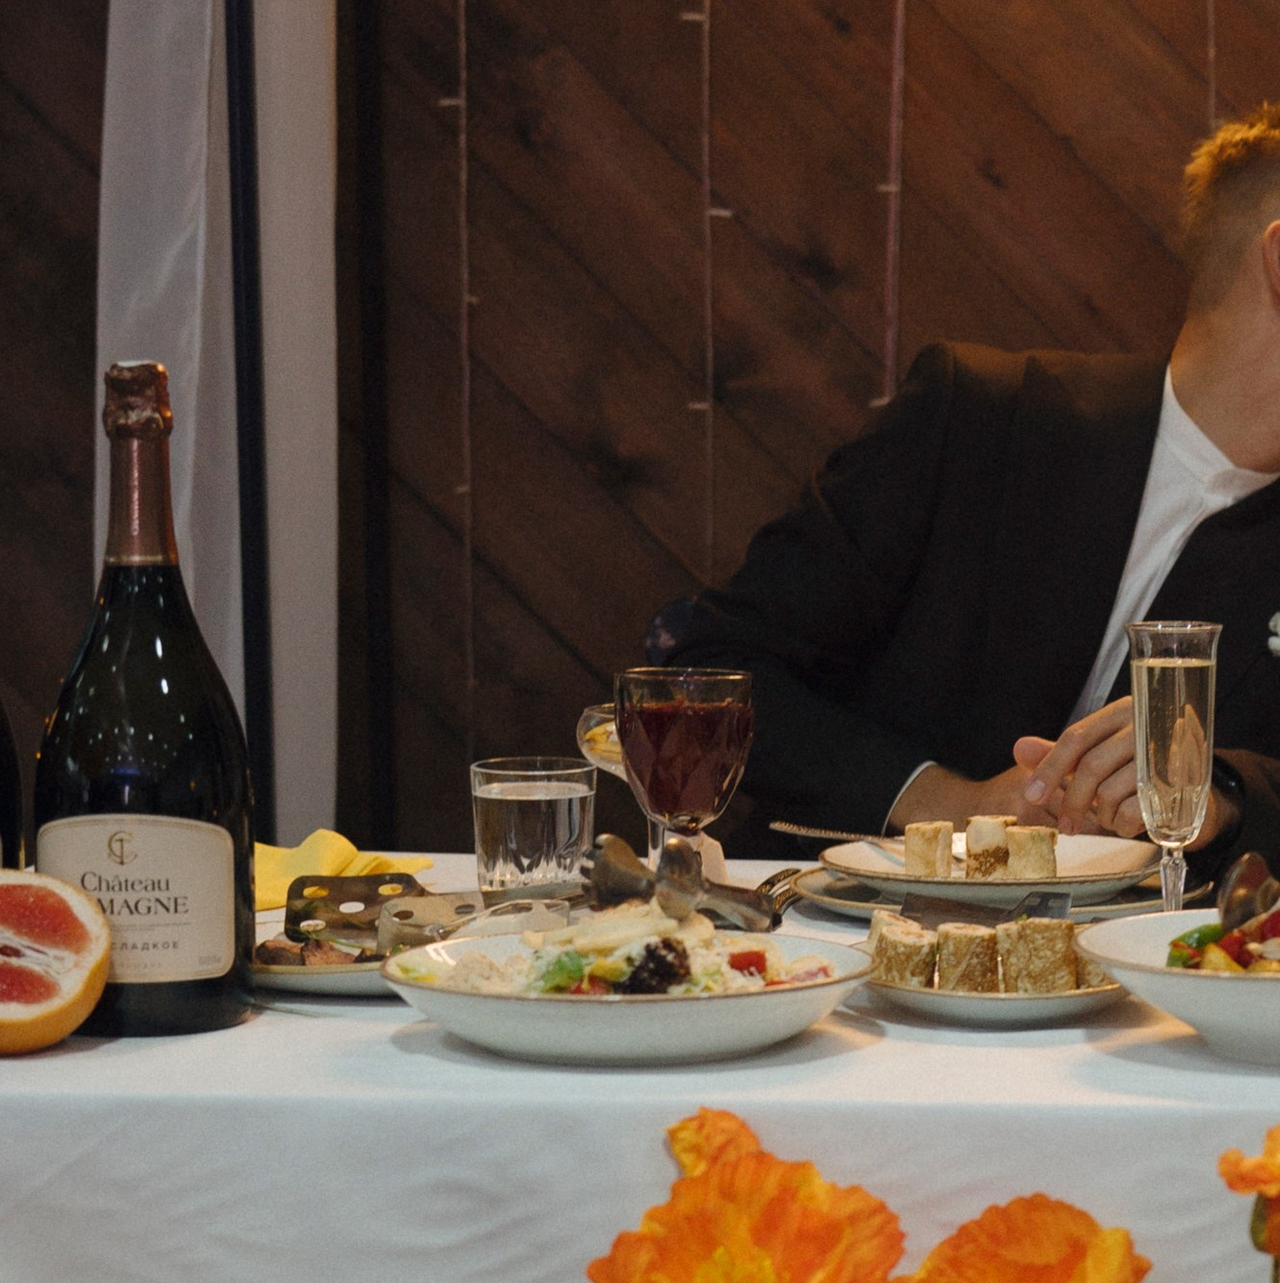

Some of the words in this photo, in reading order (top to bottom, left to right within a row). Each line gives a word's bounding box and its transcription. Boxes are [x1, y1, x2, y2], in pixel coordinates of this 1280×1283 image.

[80, 871, 171, 893] Château
[97, 896, 190, 917] MAGNE
[111, 940, 180, 953] СЛАДКОЕ
